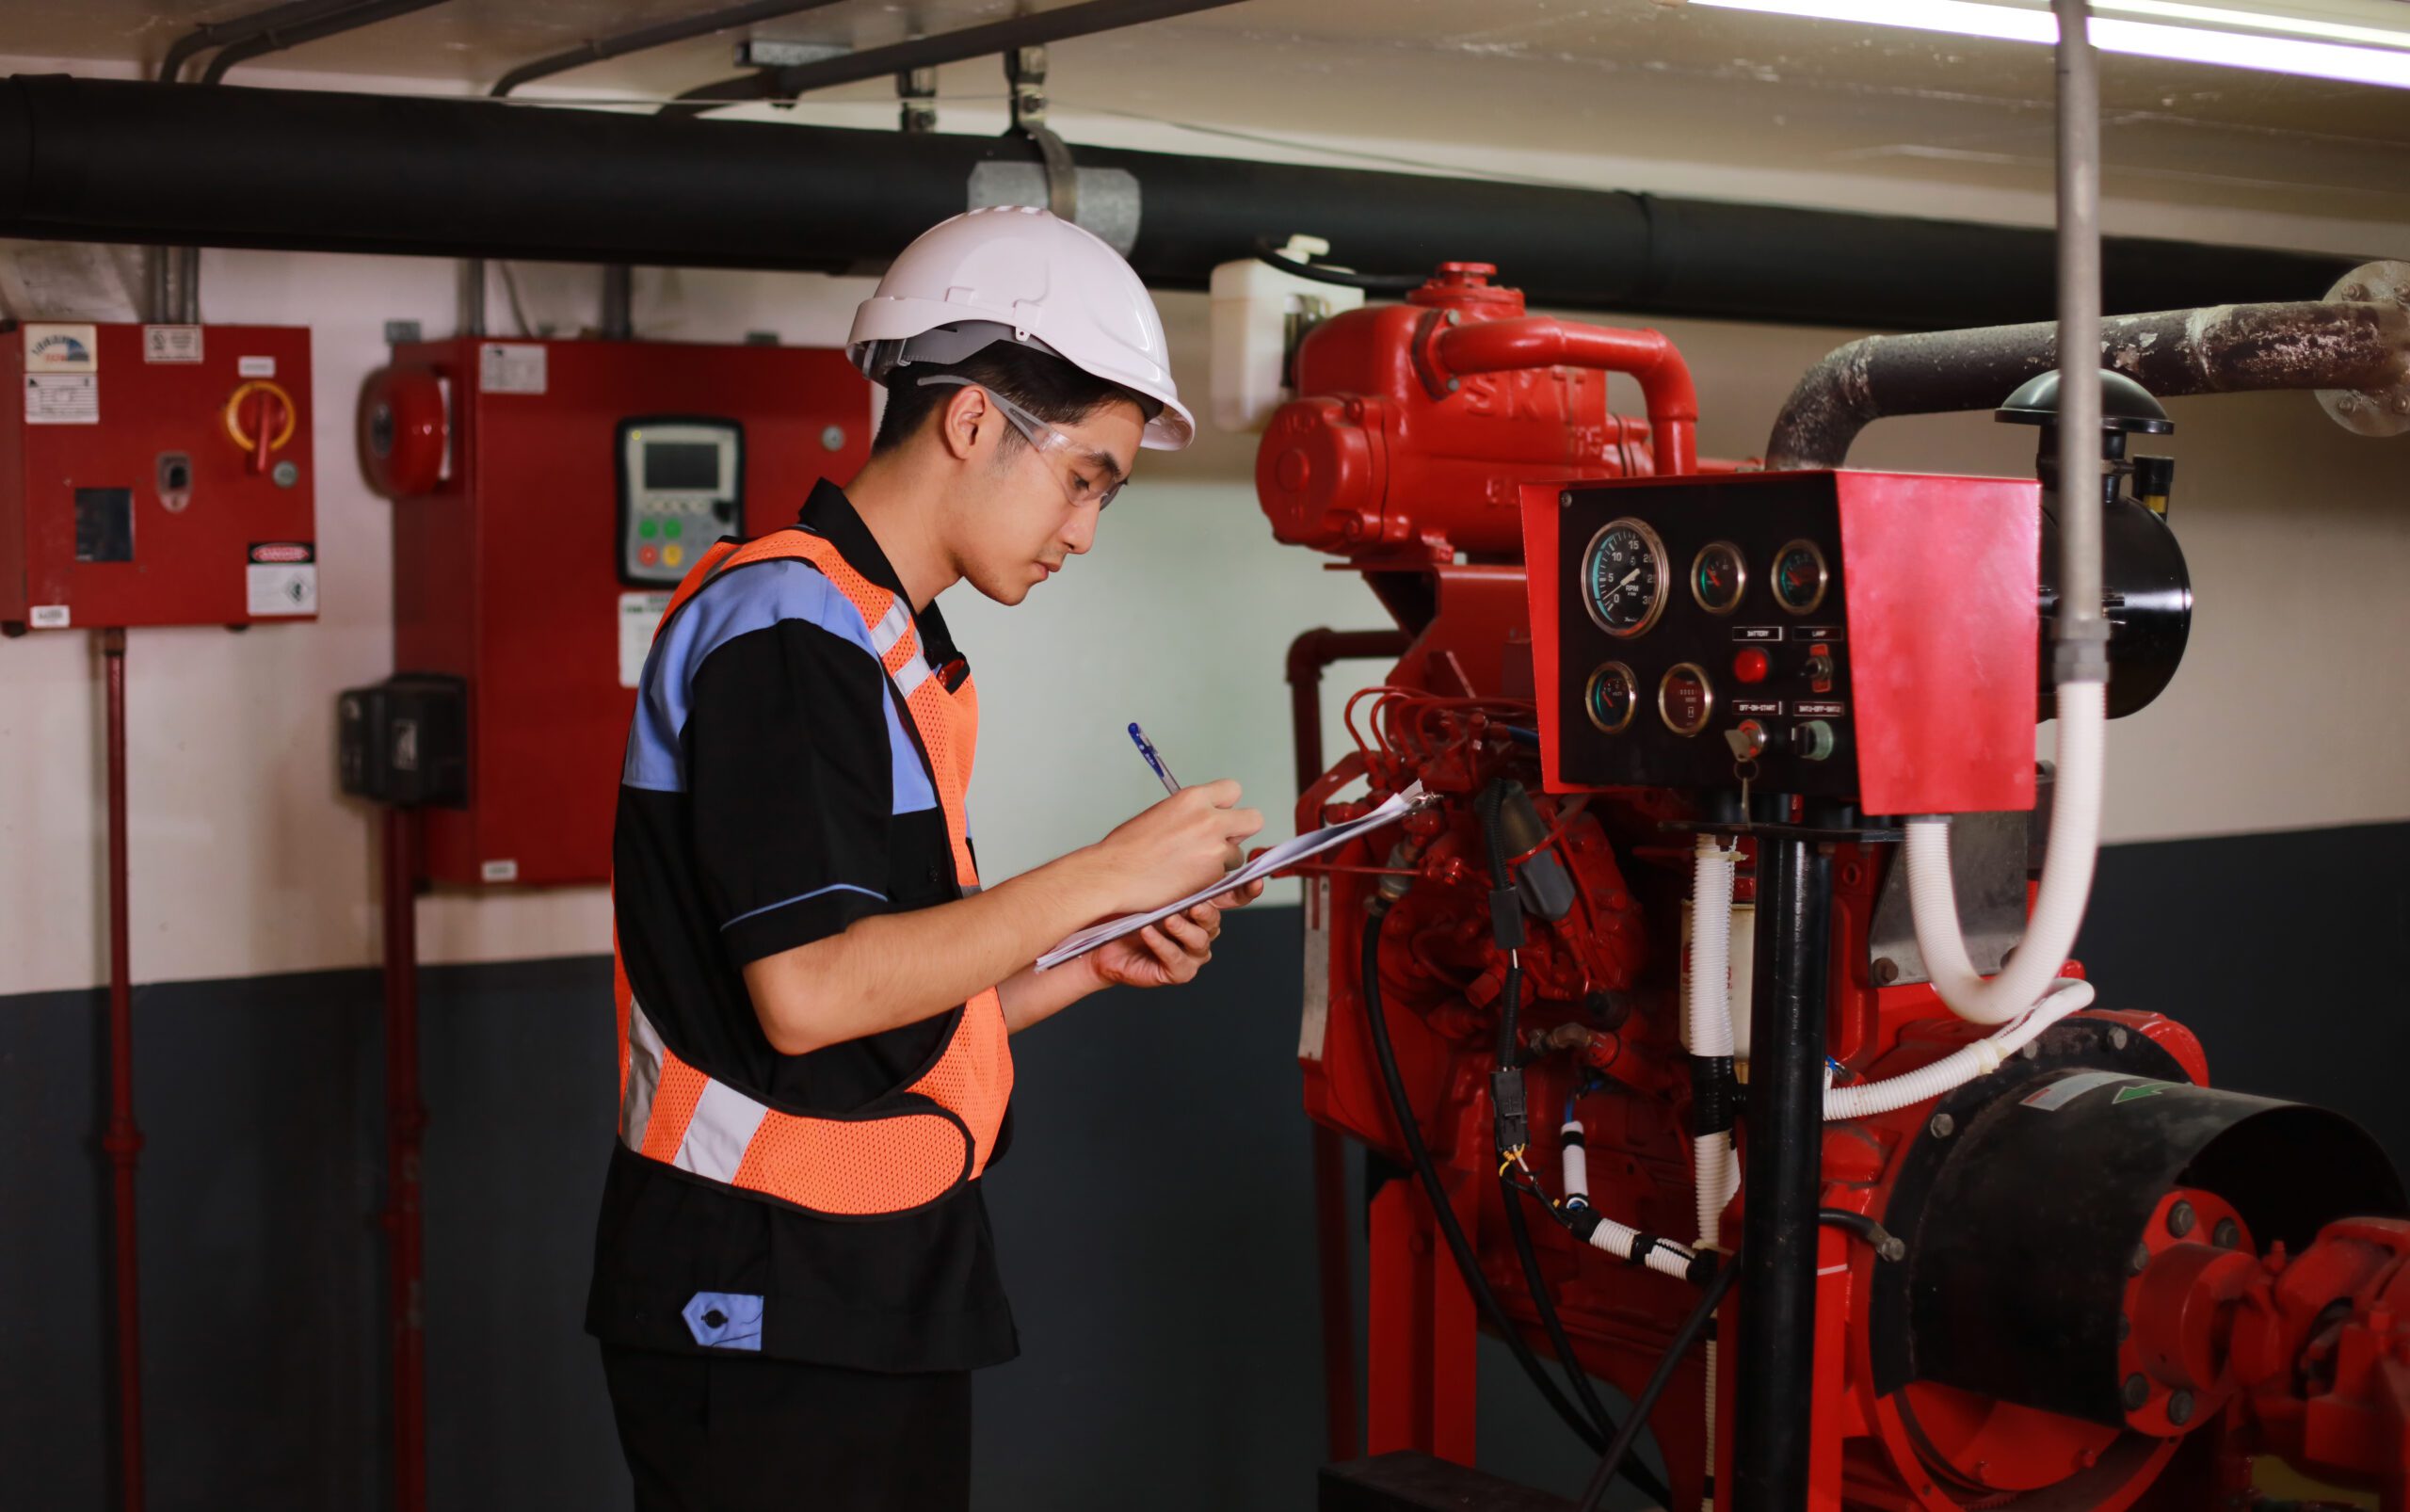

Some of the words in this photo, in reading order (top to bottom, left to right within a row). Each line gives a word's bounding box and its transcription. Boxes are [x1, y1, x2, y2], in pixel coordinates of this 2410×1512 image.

[1629, 540, 1639, 550] 15
[1612, 552, 1623, 562] 10
[1608, 572, 1614, 582] 5
[1614, 594, 1619, 603] 0
